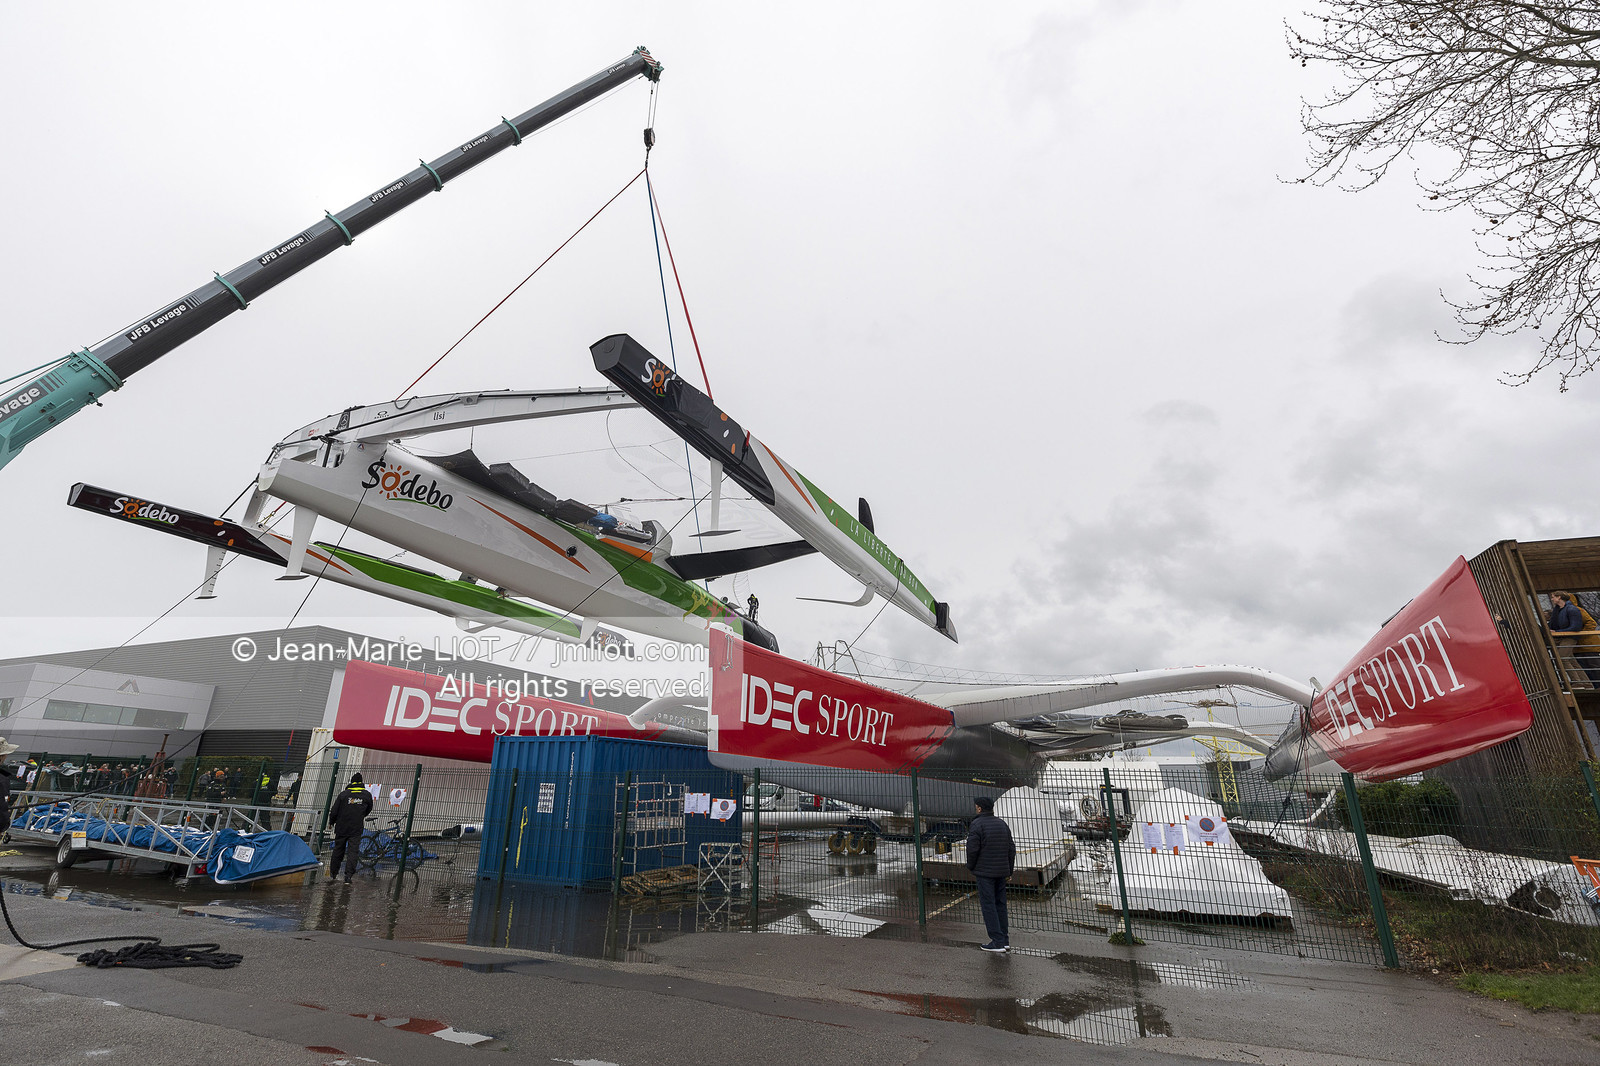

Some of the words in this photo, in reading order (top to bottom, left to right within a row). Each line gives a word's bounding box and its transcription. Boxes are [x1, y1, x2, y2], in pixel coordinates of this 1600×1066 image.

[261, 251, 277, 265] JFB
[275, 237, 305, 256] Levage
[130, 324, 151, 340] JFB
[149, 304, 187, 328] Levage
[0, 387, 41, 418] vage
[361, 461, 453, 510] Sodebo
[109, 497, 180, 525] Sodebo
[850, 520, 860, 537] LA
[1324, 673, 1375, 742] IDEC
[1359, 615, 1466, 722] SPORT
[383, 685, 488, 735] IDEC
[491, 701, 599, 737] SPORT
[740, 673, 813, 735] IDEC
[815, 694, 894, 746] SPORT
